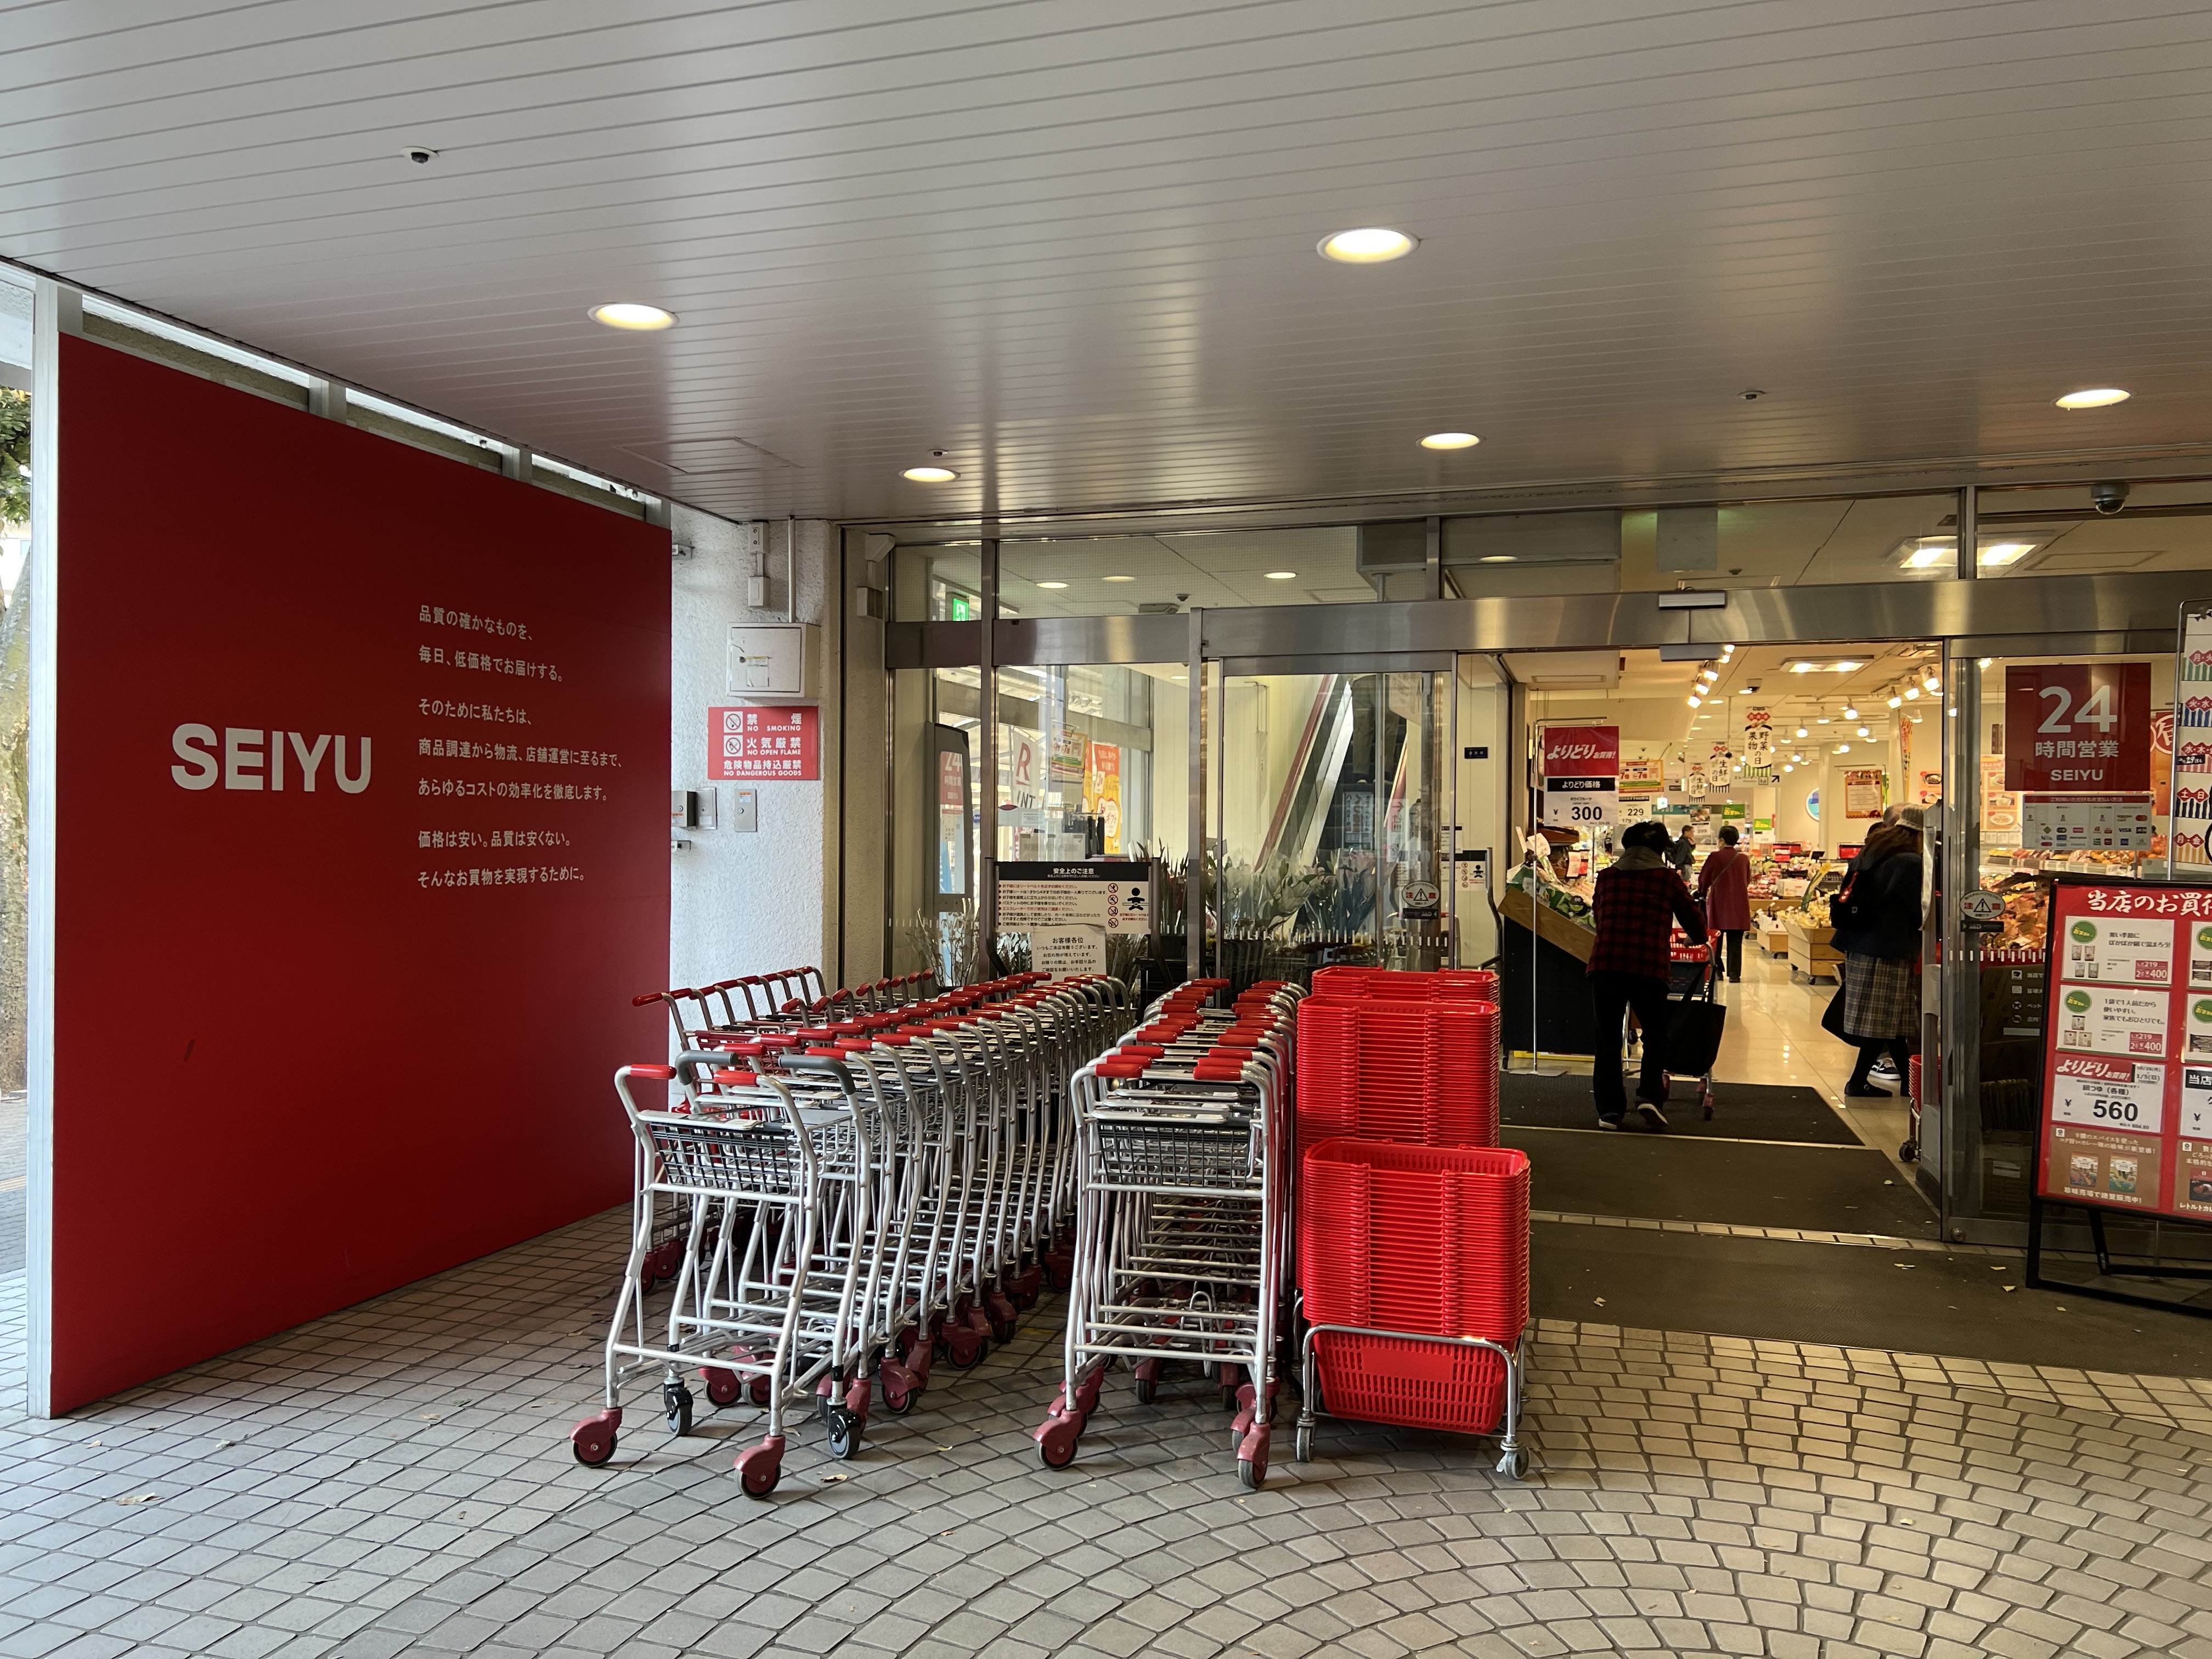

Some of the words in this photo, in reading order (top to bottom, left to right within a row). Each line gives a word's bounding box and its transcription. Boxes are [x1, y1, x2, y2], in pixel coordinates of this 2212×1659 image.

[419, 605, 533, 641] 品質の確かなものを、
[419, 645, 562, 682] 毎日、低価格でお届けする。
[419, 698, 532, 725] そのために私たちは、
[2037, 685, 2118, 734] 24
[419, 738, 622, 768] 商品調達から物流、店舗運営に至るまで、
[747, 737, 801, 749] 火気厳禁
[2035, 740, 2119, 759] 時間営業
[171, 723, 371, 794] SEIYU
[724, 759, 802, 770] 危険物品持込厳禁
[1718, 759, 1729, 777] 生鮮
[1562, 781, 1601, 789] よりどり価格
[2051, 769, 2103, 782] SEIYU
[418, 777, 607, 802] あらゆるコストの効率化を徹底します。
[1571, 806, 1602, 820] 300
[418, 830, 570, 849] 価格は安い。品質は安くない。
[418, 866, 584, 889] そんなお買物を実現するために。
[2065, 1099, 2072, 1107] ¥
[2093, 1099, 2138, 1122] 560
[2193, 1113, 2201, 1122] ¥
